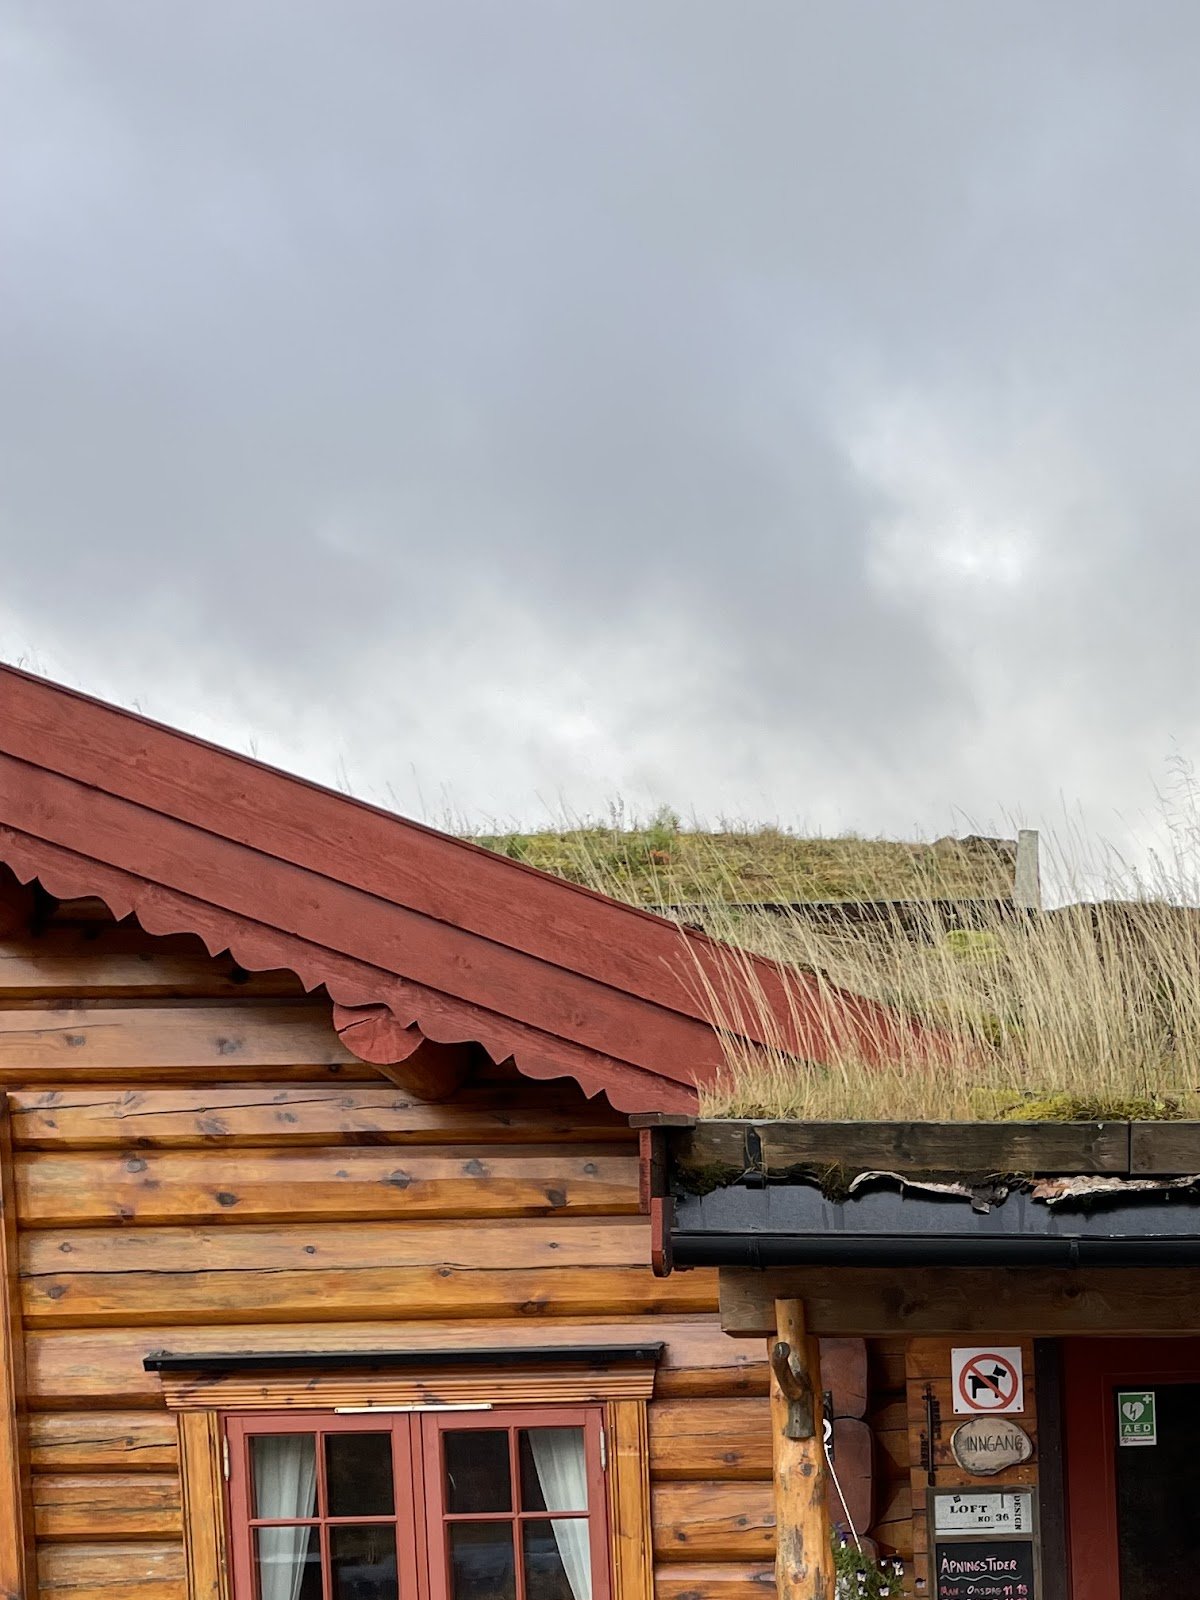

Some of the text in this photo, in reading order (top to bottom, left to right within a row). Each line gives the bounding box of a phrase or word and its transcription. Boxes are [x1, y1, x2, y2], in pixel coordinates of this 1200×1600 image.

[1124, 1424, 1151, 1433] AED
[966, 1434, 1023, 1453] INNGANG
[949, 1504, 988, 1514] LOFT
[1013, 1495, 1022, 1531] DESIGN
[995, 1513, 1010, 1522] 36
